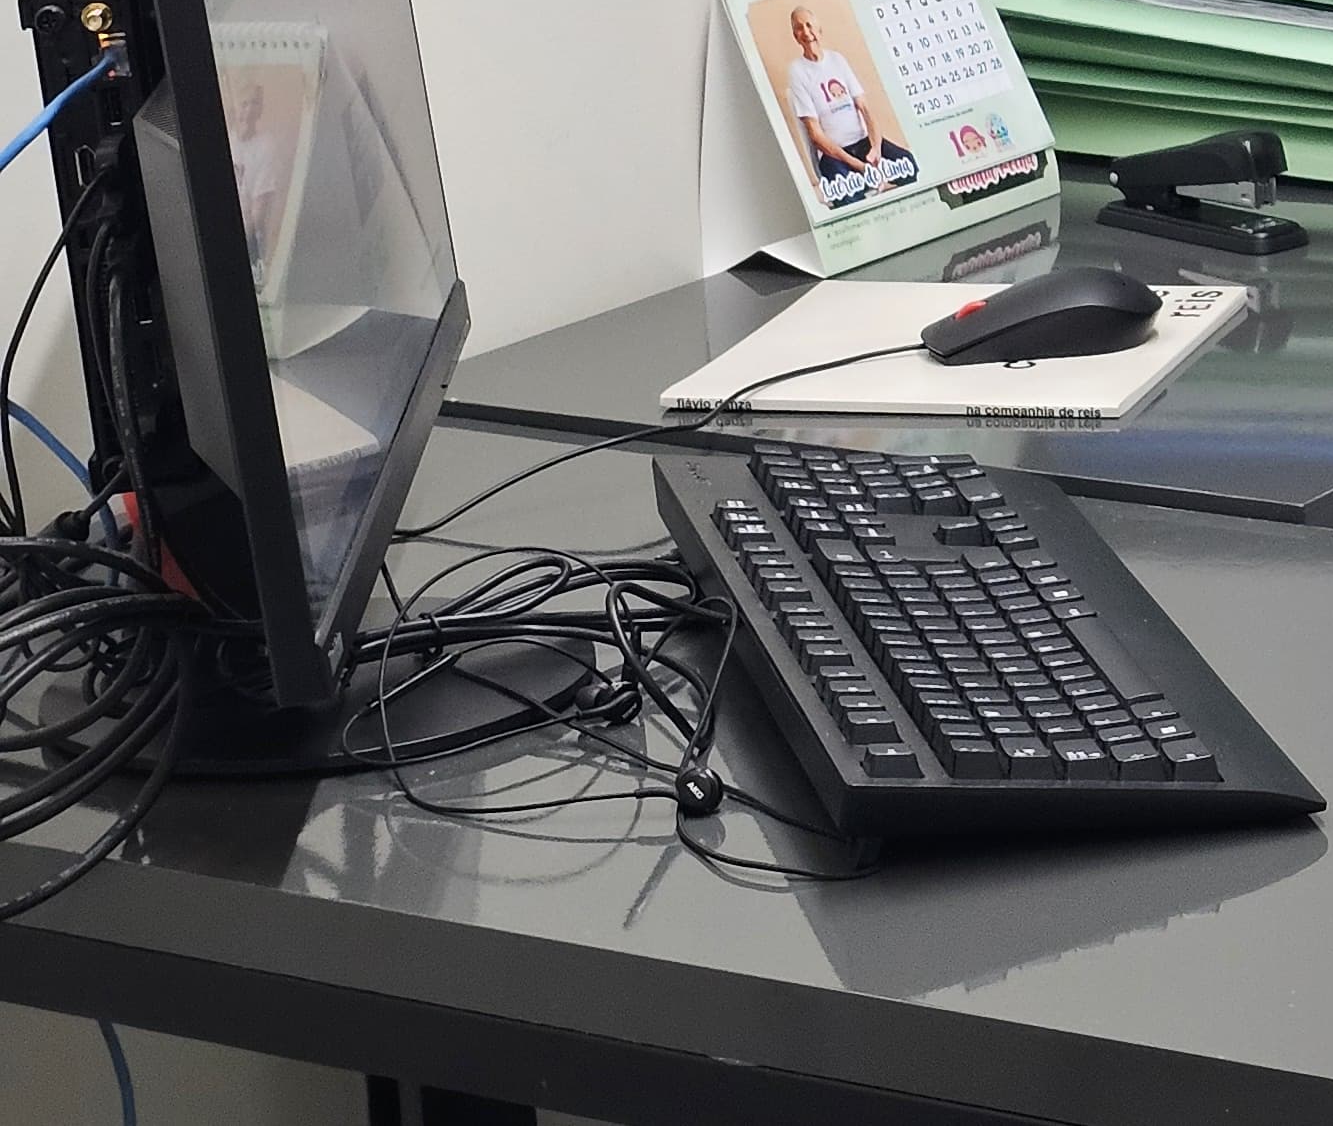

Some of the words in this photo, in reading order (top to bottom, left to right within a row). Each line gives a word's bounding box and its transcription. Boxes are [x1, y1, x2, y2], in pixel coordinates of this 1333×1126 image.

[876, 7, 885, 19] D
[891, 3, 899, 15] S
[905, 0, 913, 11] T
[885, 26, 892, 38] 1
[900, 23, 907, 34] 2
[913, 18, 921, 30] 3
[928, 15, 935, 25] 4
[941, 10, 949, 21] 5
[955, 6, 963, 17] 6
[968, 2, 976, 14] 7
[893, 46, 901, 58] 8
[906, 42, 914, 53] 9
[919, 36, 931, 49] 10
[934, 33, 944, 44] 11
[947, 29, 959, 41] 12
[961, 25, 972, 36] 13
[974, 21, 986, 32] 14
[899, 64, 910, 77] 15
[913, 60, 924, 72] 16
[927, 56, 937, 68] 17
[941, 52, 952, 64] 18
[955, 47, 965, 60] 19
[968, 42, 981, 56] 20
[983, 39, 994, 52] 21
[905, 83, 918, 96] 22
[920, 78, 934, 92] 23
[934, 75, 948, 88] 24
[949, 70, 962, 84] 25
[963, 66, 976, 80] 26
[976, 61, 988, 75] 27
[990, 57, 1003, 70] 28
[913, 103, 927, 116] 29
[927, 97, 941, 111] 30
[943, 93, 955, 106] 31
[865, 163, 880, 188] de
[676, 398, 711, 410] flávio
[966, 405, 980, 417] na
[984, 405, 1055, 419] companhia
[1058, 407, 1075, 419] de
[1078, 407, 1102, 419] reis
